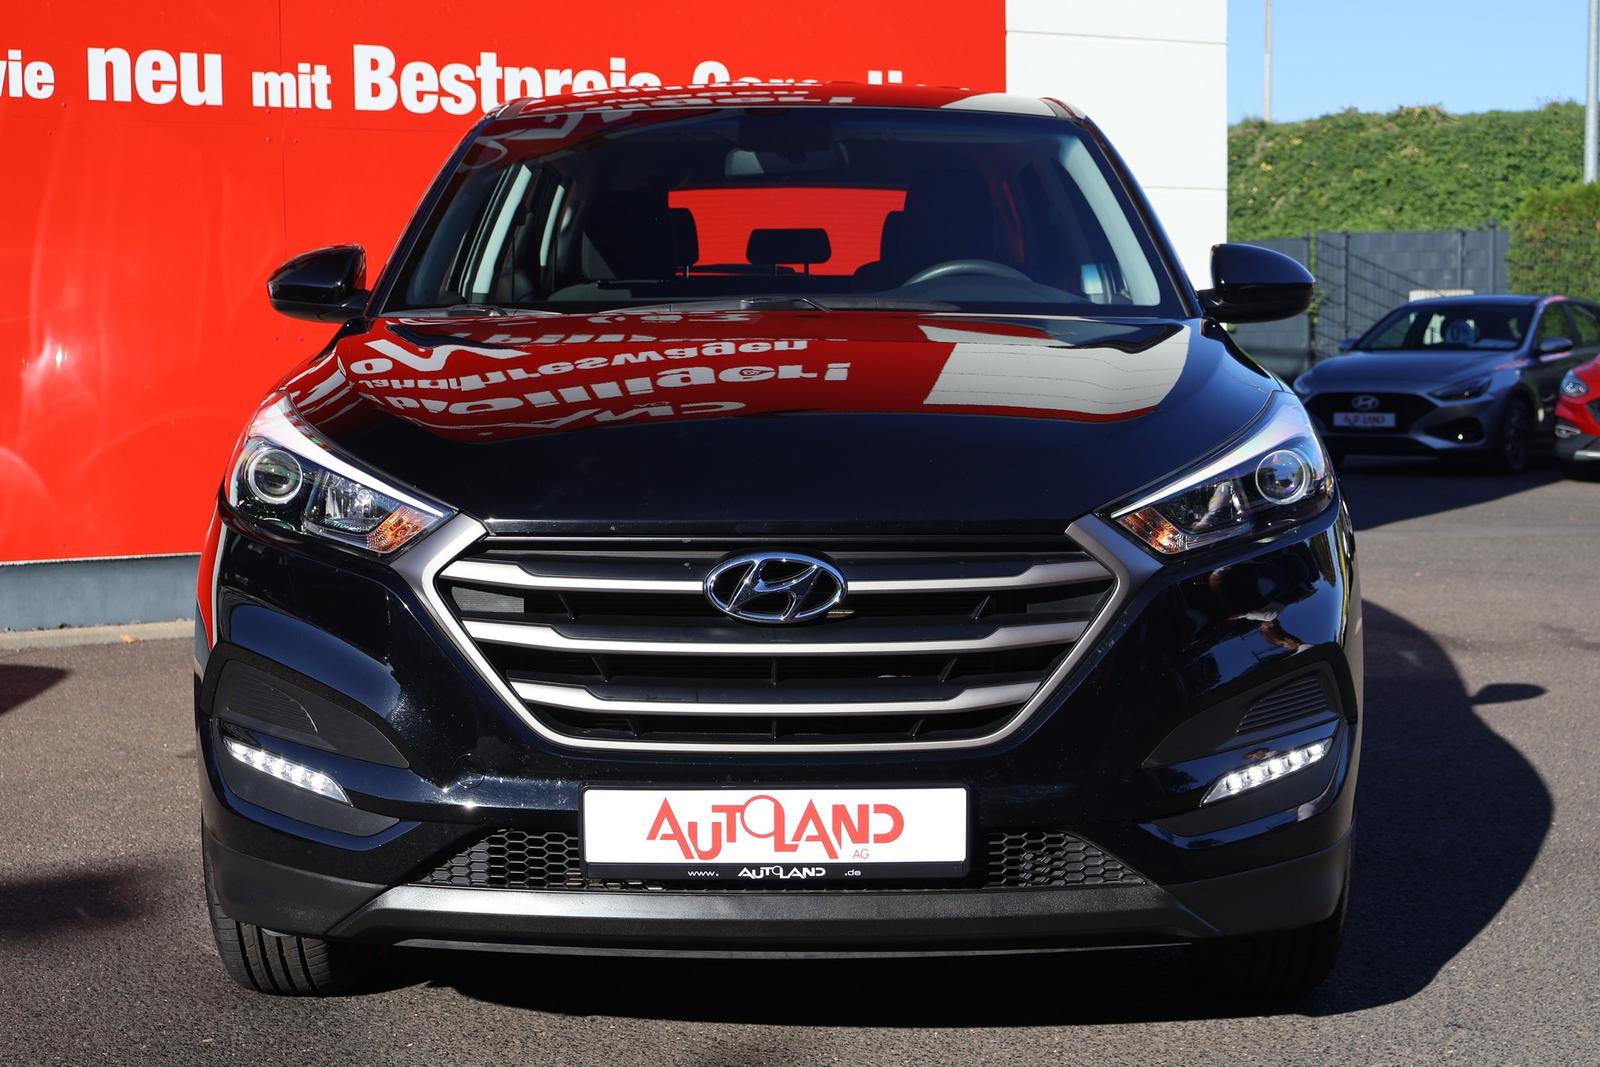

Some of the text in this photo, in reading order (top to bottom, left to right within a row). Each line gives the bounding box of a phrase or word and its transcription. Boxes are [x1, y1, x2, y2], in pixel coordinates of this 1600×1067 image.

[87, 47, 223, 106] neu
[252, 63, 332, 110] mit
[646, 795, 905, 860] AUTOLAND
[738, 865, 826, 879] AUTOLAND
[844, 869, 862, 877] .de
[852, 849, 870, 859] AG
